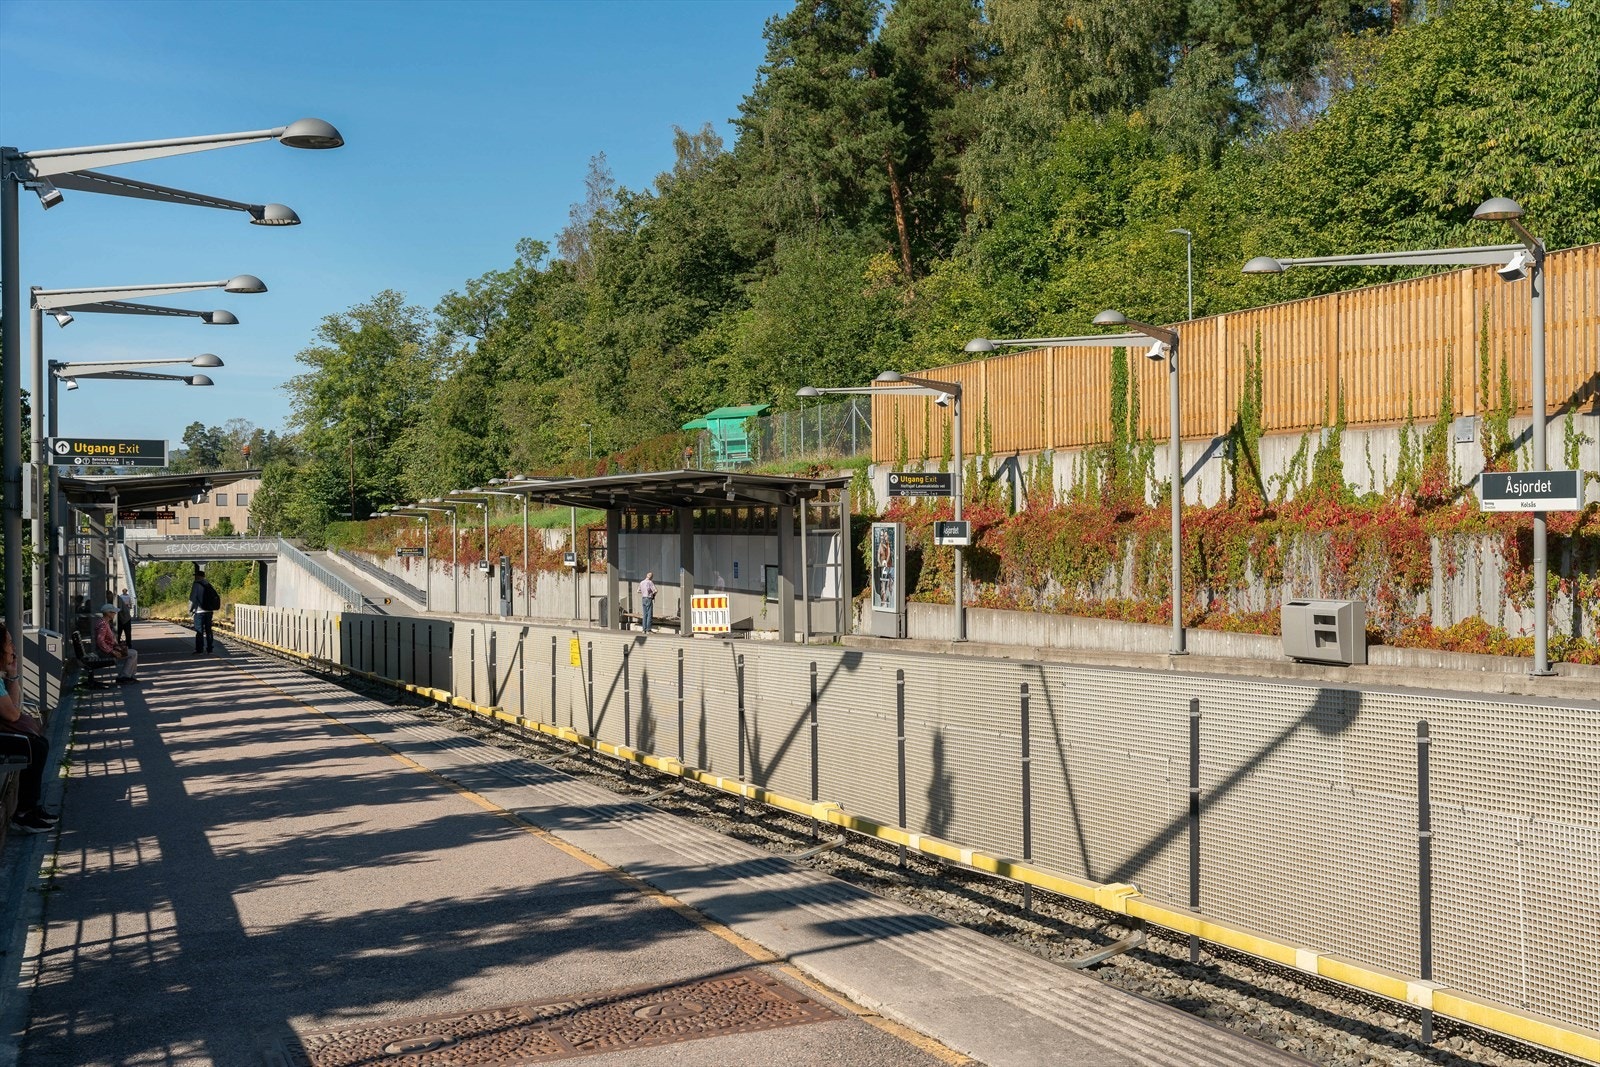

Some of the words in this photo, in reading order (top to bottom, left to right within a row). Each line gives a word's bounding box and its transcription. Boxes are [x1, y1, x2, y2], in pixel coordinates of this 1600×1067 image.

[74, 442, 116, 455] Utgang
[118, 443, 140, 454] Exit
[900, 475, 924, 484] Utgang
[924, 475, 937, 483] Exit
[1505, 475, 1552, 497] Åsjordet
